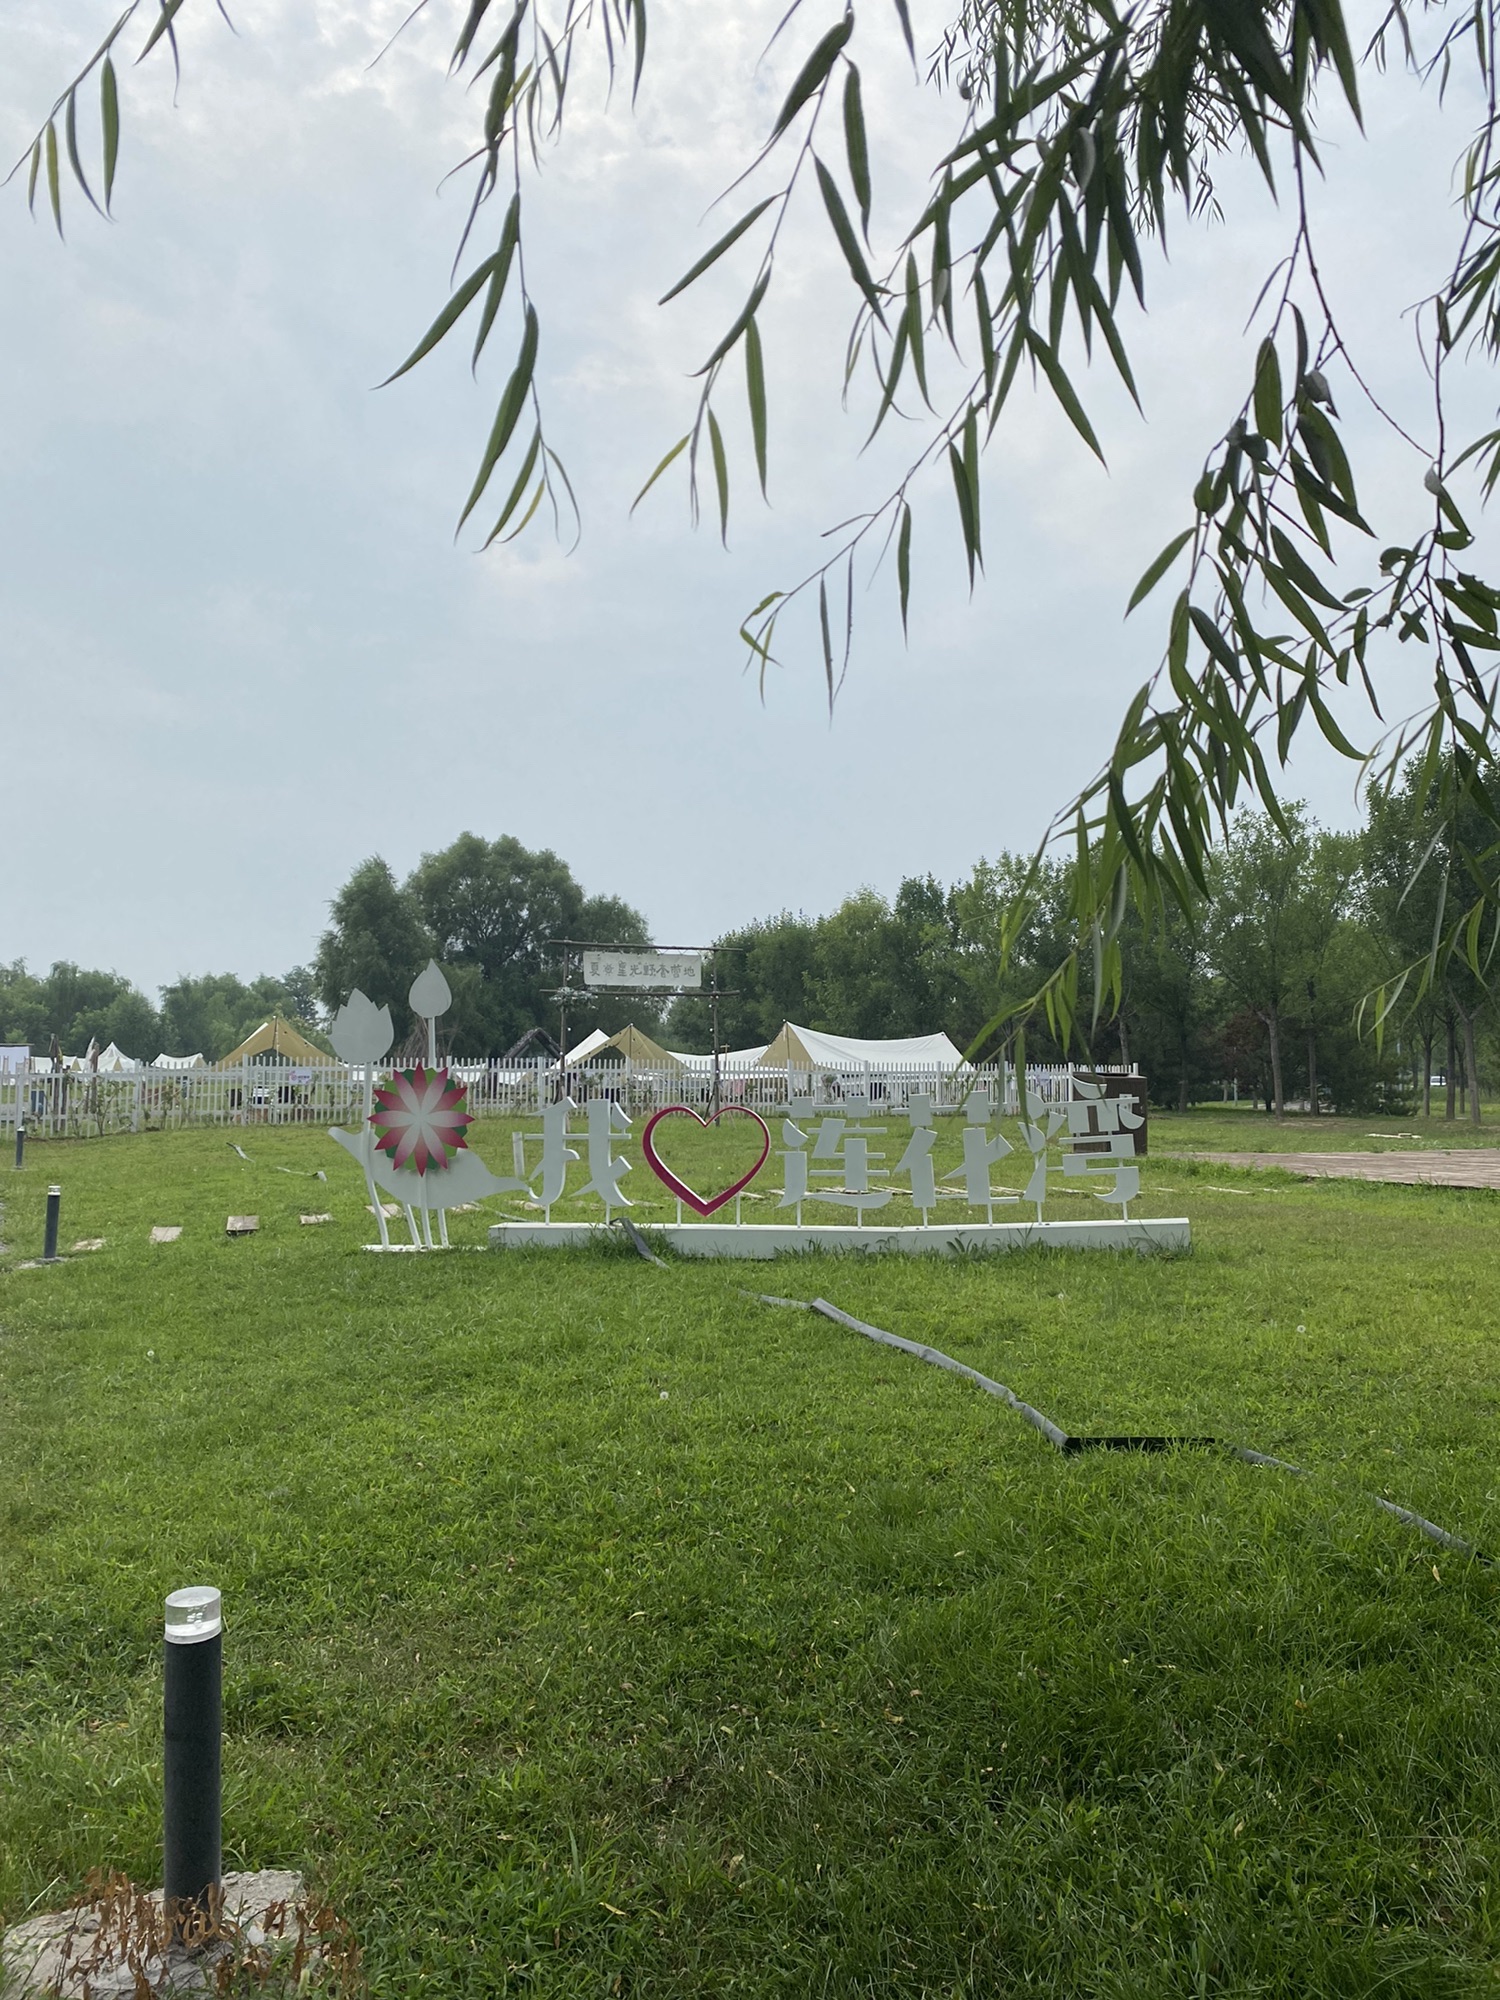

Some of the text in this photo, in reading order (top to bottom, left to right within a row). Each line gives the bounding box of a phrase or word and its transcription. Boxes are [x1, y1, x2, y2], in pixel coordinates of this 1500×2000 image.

[524, 1076, 1145, 1208] 我 莲花湾
